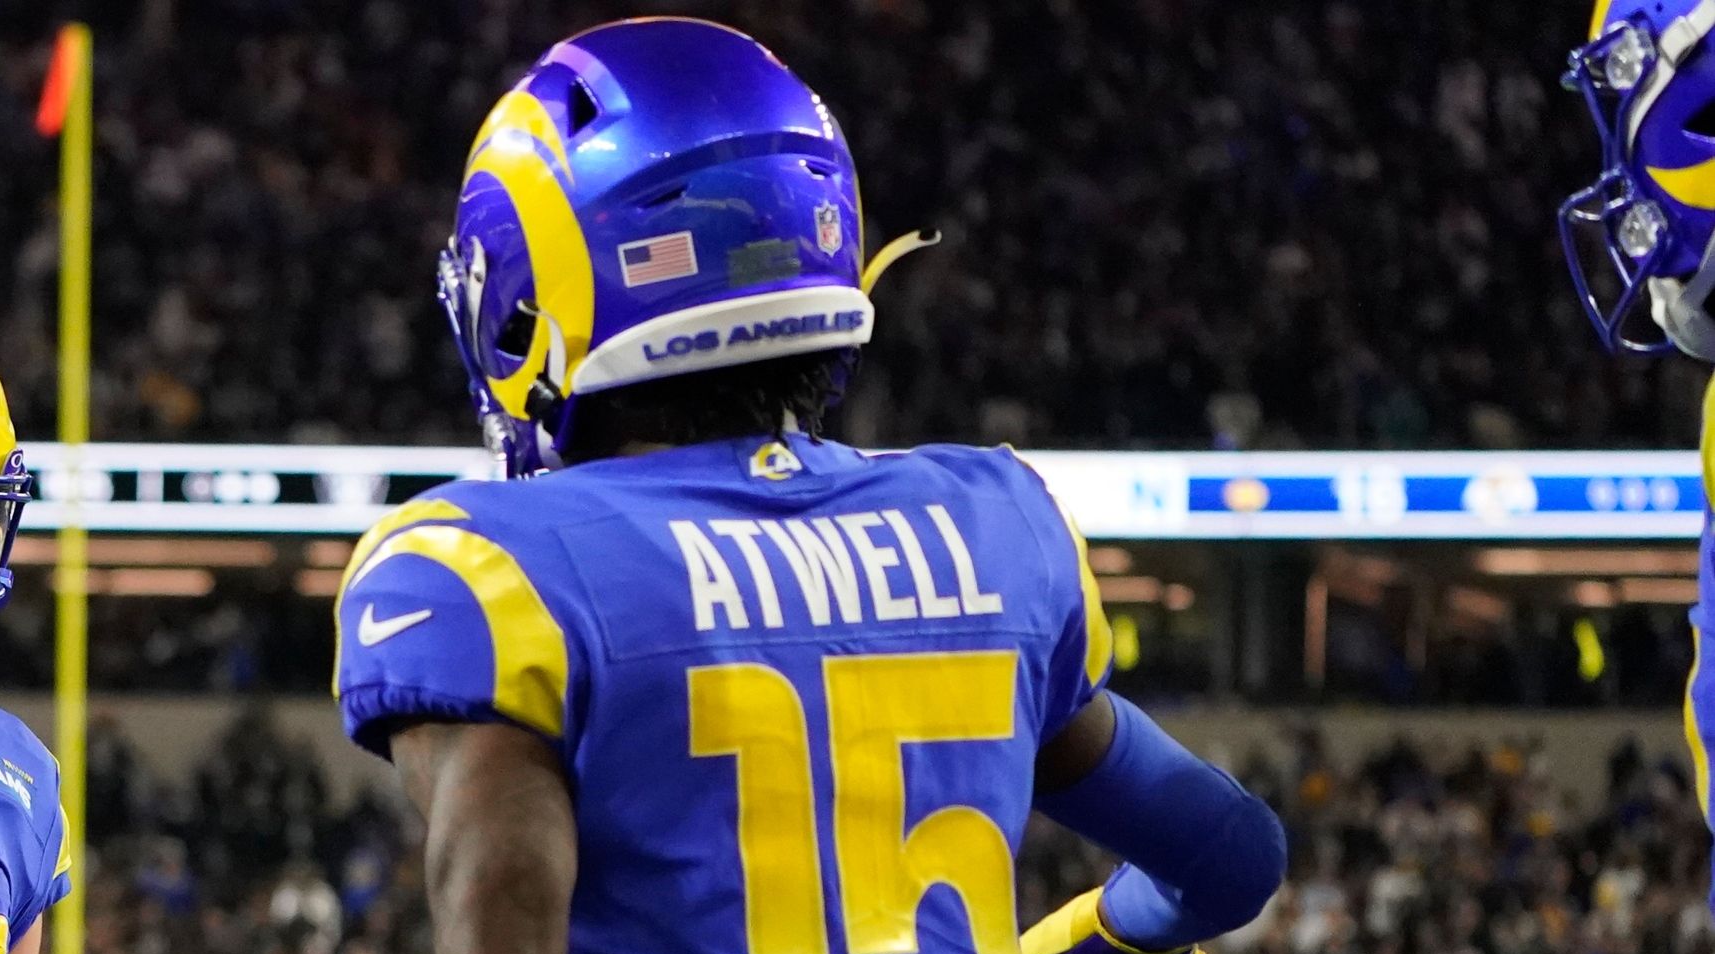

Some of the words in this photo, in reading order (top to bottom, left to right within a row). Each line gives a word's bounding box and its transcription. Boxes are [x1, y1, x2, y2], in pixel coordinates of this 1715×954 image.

[642, 330, 720, 362] LOS
[726, 309, 864, 346] ANGELES
[668, 503, 1004, 633] ATWELL
